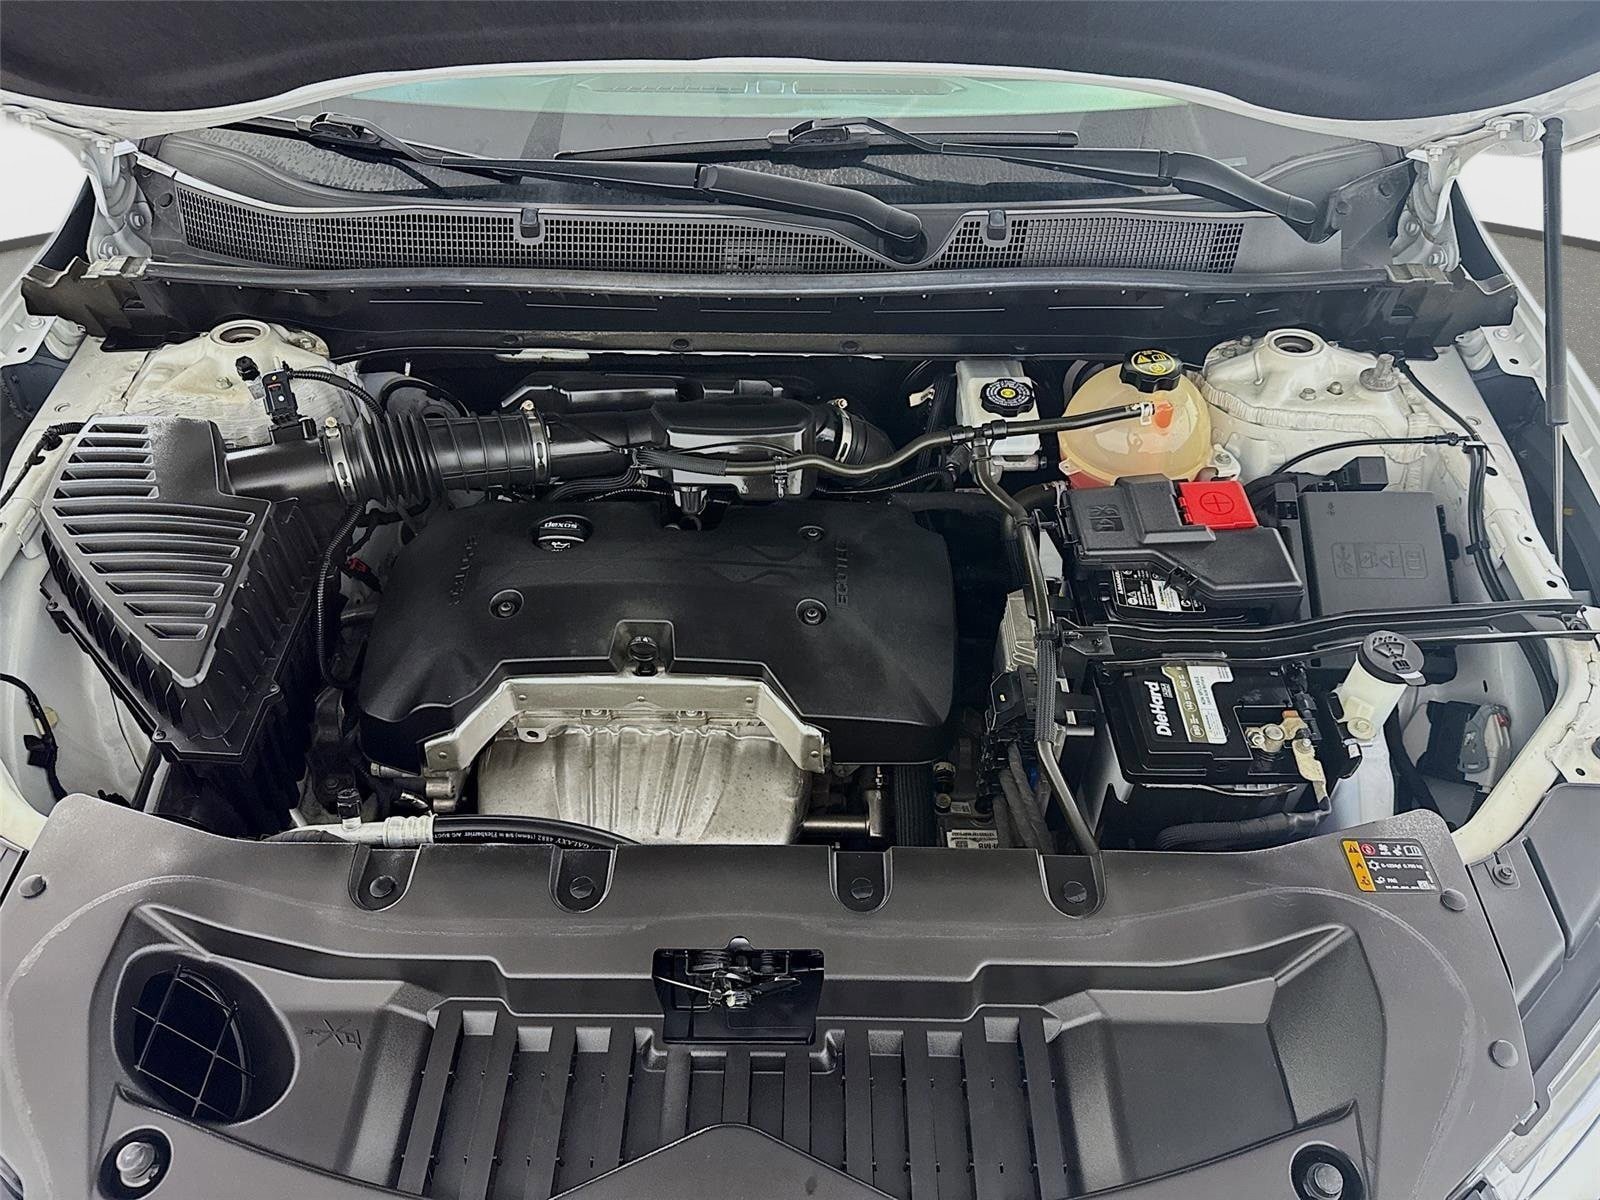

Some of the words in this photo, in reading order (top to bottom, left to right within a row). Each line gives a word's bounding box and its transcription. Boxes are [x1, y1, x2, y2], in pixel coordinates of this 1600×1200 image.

[544, 521, 578, 529] dexos
[1144, 680, 1173, 737] DieHard
[555, 838, 589, 849] GALAXY
